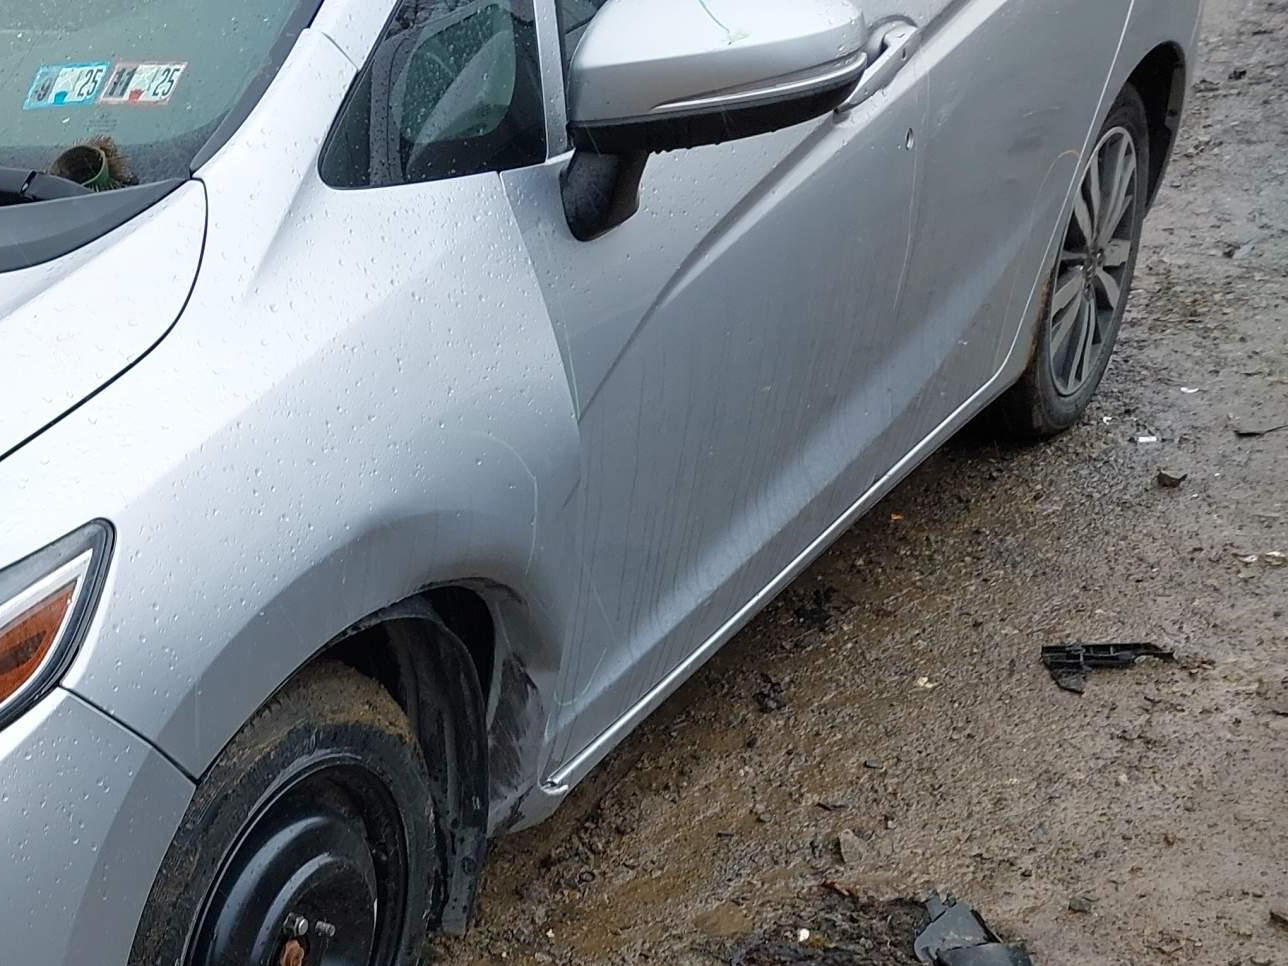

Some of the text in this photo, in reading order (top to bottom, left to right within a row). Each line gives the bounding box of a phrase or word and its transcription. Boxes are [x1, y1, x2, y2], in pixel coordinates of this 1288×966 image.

[76, 68, 104, 97] 25
[108, 67, 181, 98] 11 25
